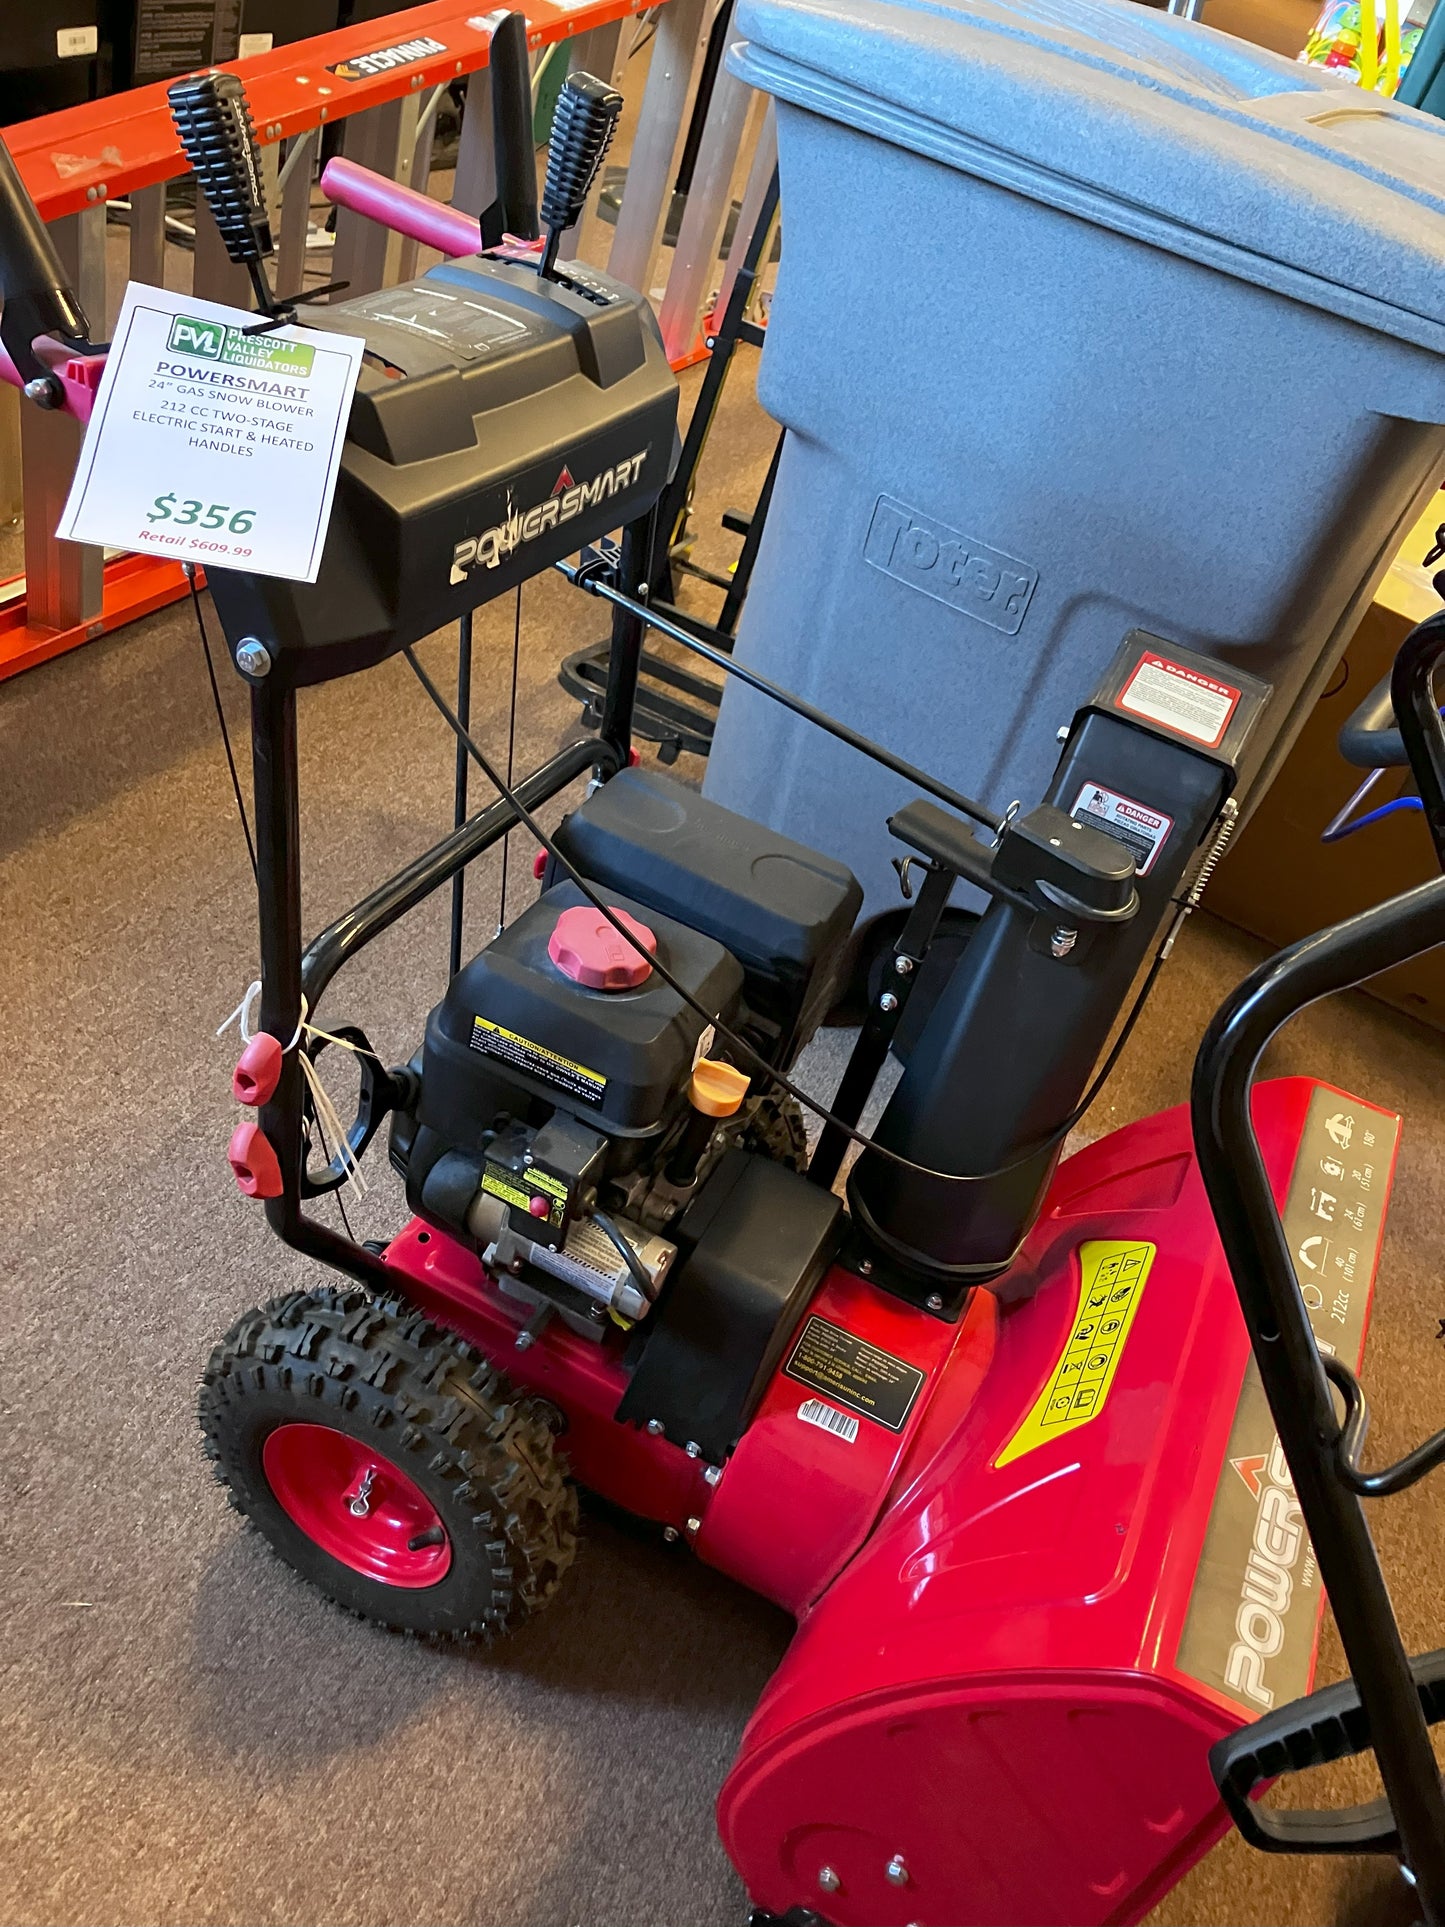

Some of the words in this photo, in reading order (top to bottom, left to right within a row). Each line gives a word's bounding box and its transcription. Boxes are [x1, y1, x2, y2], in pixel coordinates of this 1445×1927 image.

[349, 37, 447, 73] PINNACLE
[173, 324, 217, 354] PVL
[226, 340, 273, 359] VALLEY
[228, 329, 298, 353] PRESCOTT
[223, 352, 308, 376] LIQUIDATORS
[156, 361, 310, 400] POWERSMART
[160, 400, 186, 413] 212
[191, 405, 209, 417] CC
[212, 409, 294, 432] TWO-STAGE
[176, 384, 204, 397] GAS
[208, 390, 253, 406] SNOW
[256, 399, 314, 417] BLOWER
[133, 410, 197, 431] ELECTRIC
[200, 423, 243, 438] START
[246, 431, 257, 442] &
[261, 434, 314, 452] HEATED
[188, 437, 253, 457] HANDLES
[146, 492, 257, 534] $356
[450, 444, 648, 586] POWERSMART
[138, 530, 186, 546] Retail
[189, 539, 253, 557] $609.99
[1165, 664, 1229, 695] DANGER
[1125, 807, 1160, 829] DANGER
[508, 1034, 579, 1069] CAUTION/ATTENTION
[1330, 1289, 1350, 1324] 212cc
